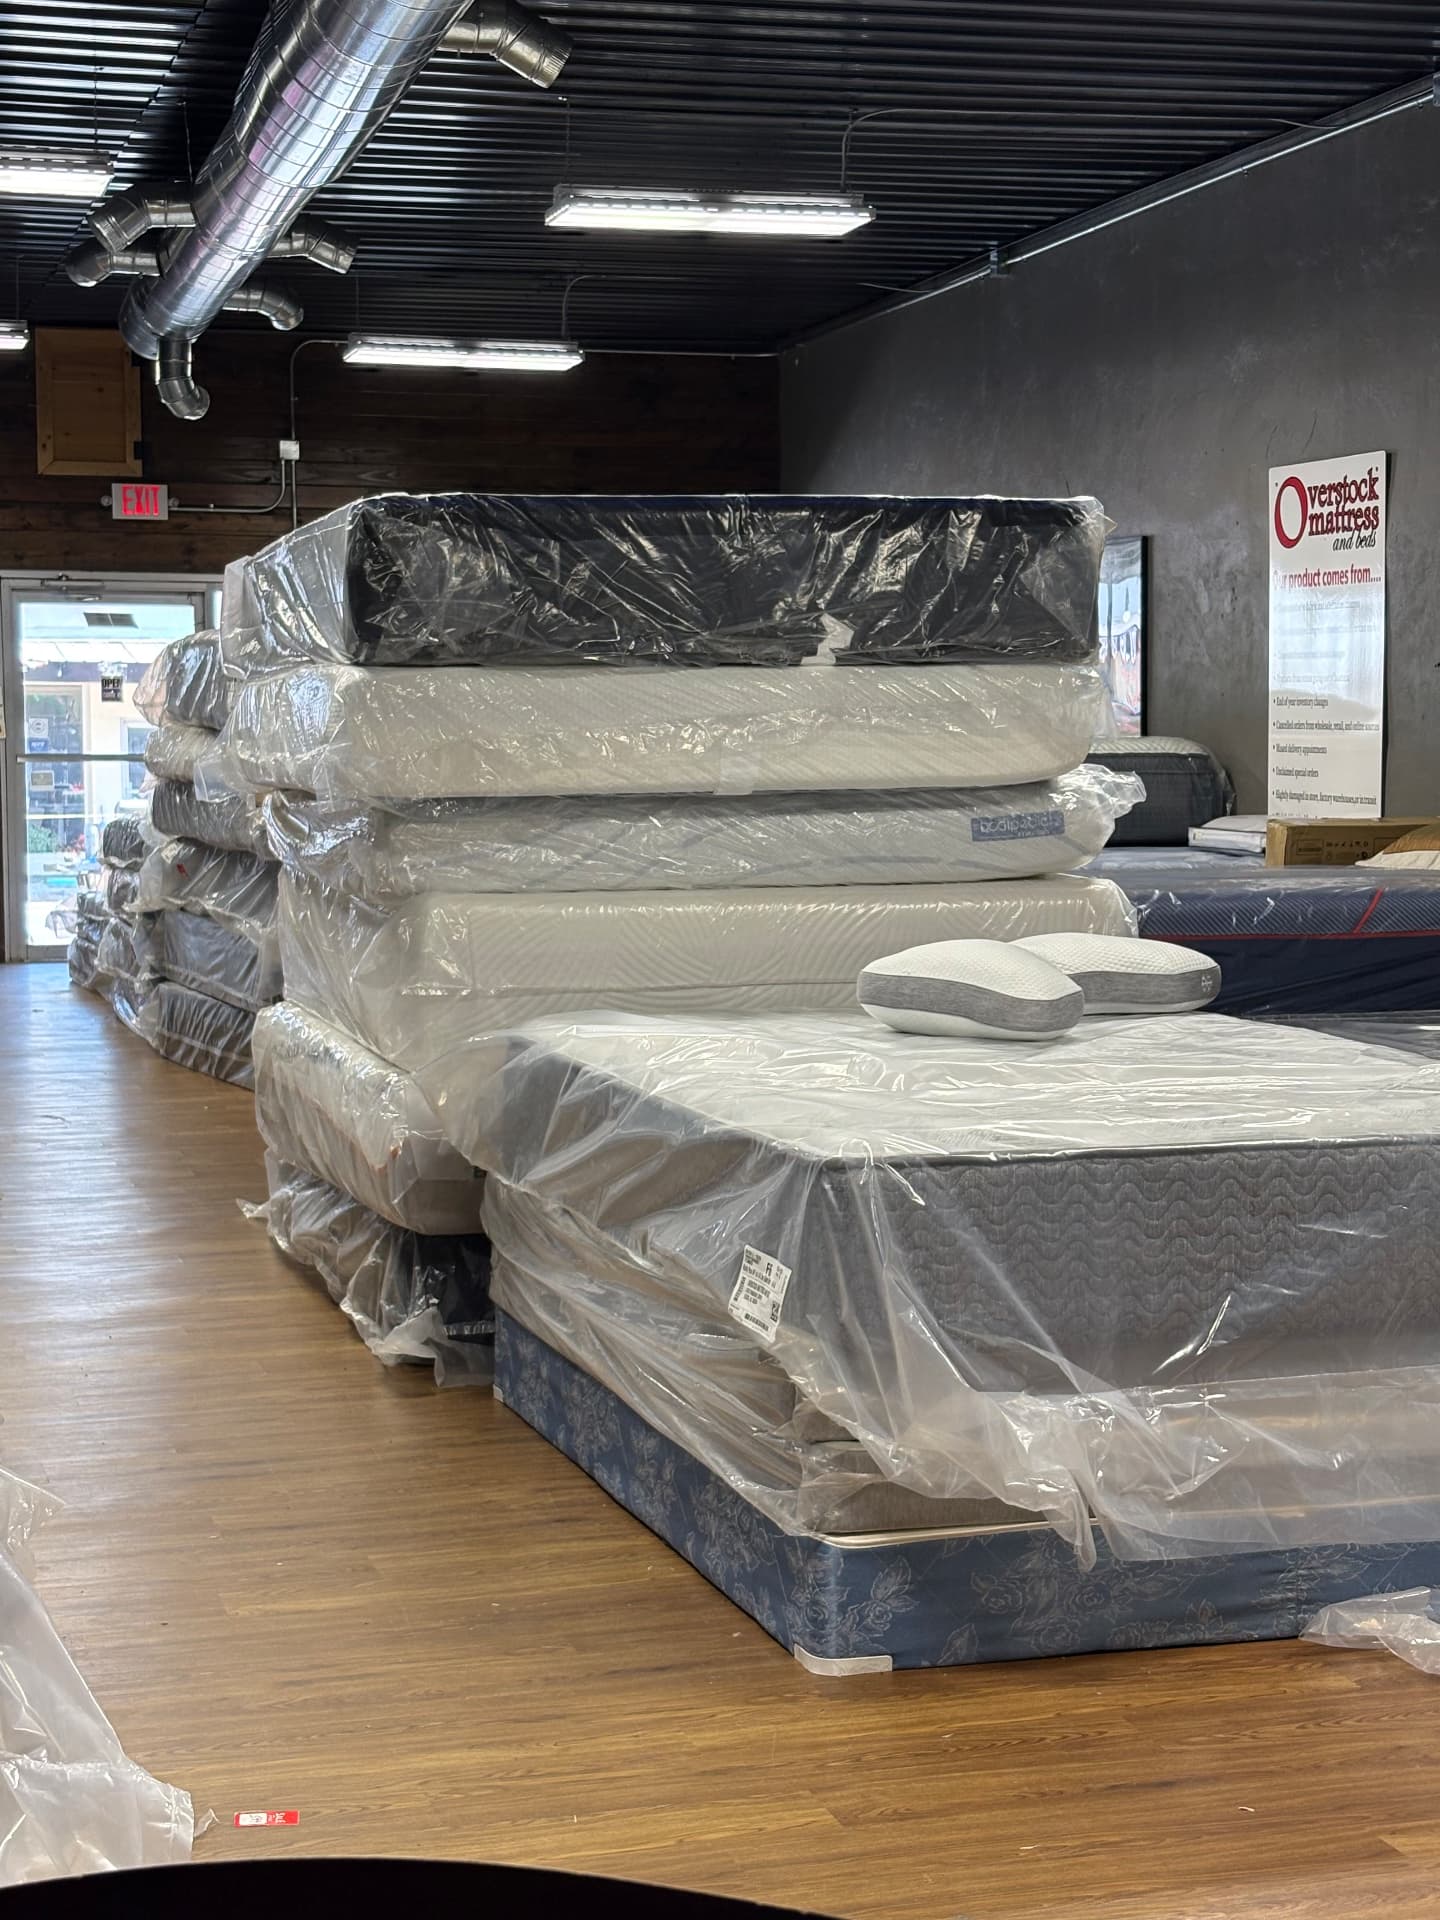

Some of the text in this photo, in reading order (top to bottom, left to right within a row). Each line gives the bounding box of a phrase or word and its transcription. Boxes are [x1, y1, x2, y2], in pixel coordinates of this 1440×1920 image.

[122, 485, 160, 516] EXIT
[1274, 467, 1379, 549] Overstock
[1308, 503, 1379, 536] mattress
[1333, 530, 1376, 551] and beds
[1289, 568, 1320, 589] product
[1322, 570, 1348, 586] comes
